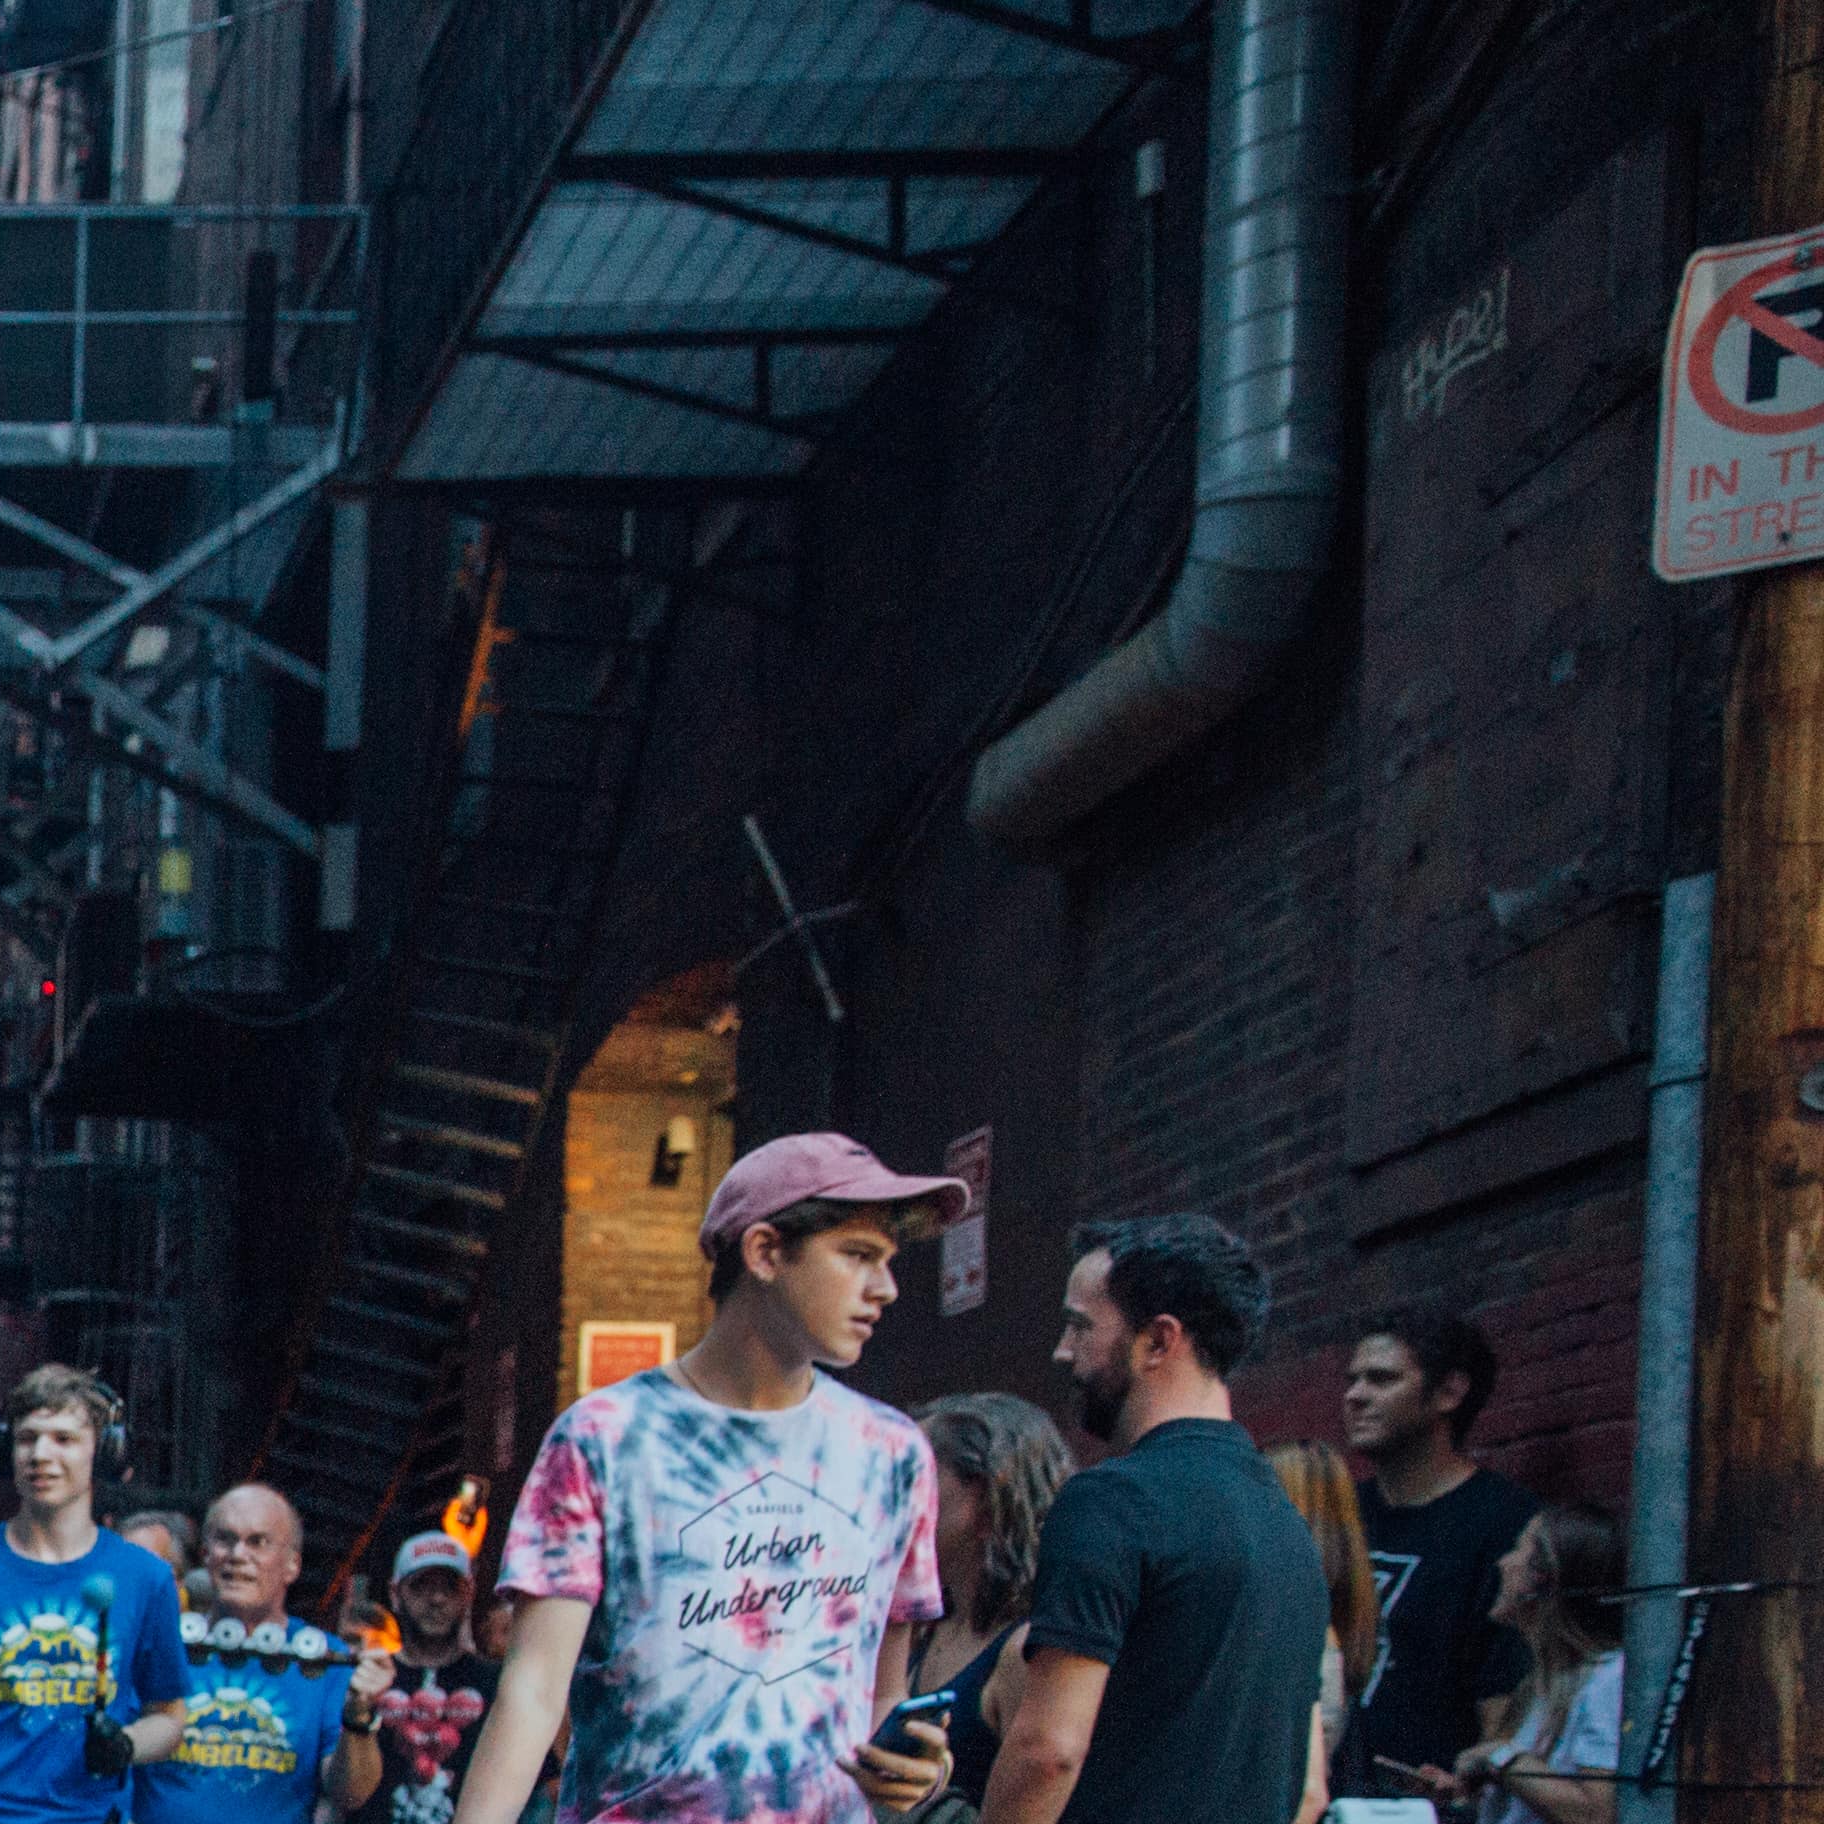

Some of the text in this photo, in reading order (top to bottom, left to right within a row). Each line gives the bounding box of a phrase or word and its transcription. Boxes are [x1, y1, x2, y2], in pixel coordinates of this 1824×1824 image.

[1687, 458, 1740, 502] IN
[1686, 493, 1824, 553] STRE
[723, 1525, 826, 1571] Urban
[678, 1557, 873, 1631] Underground
